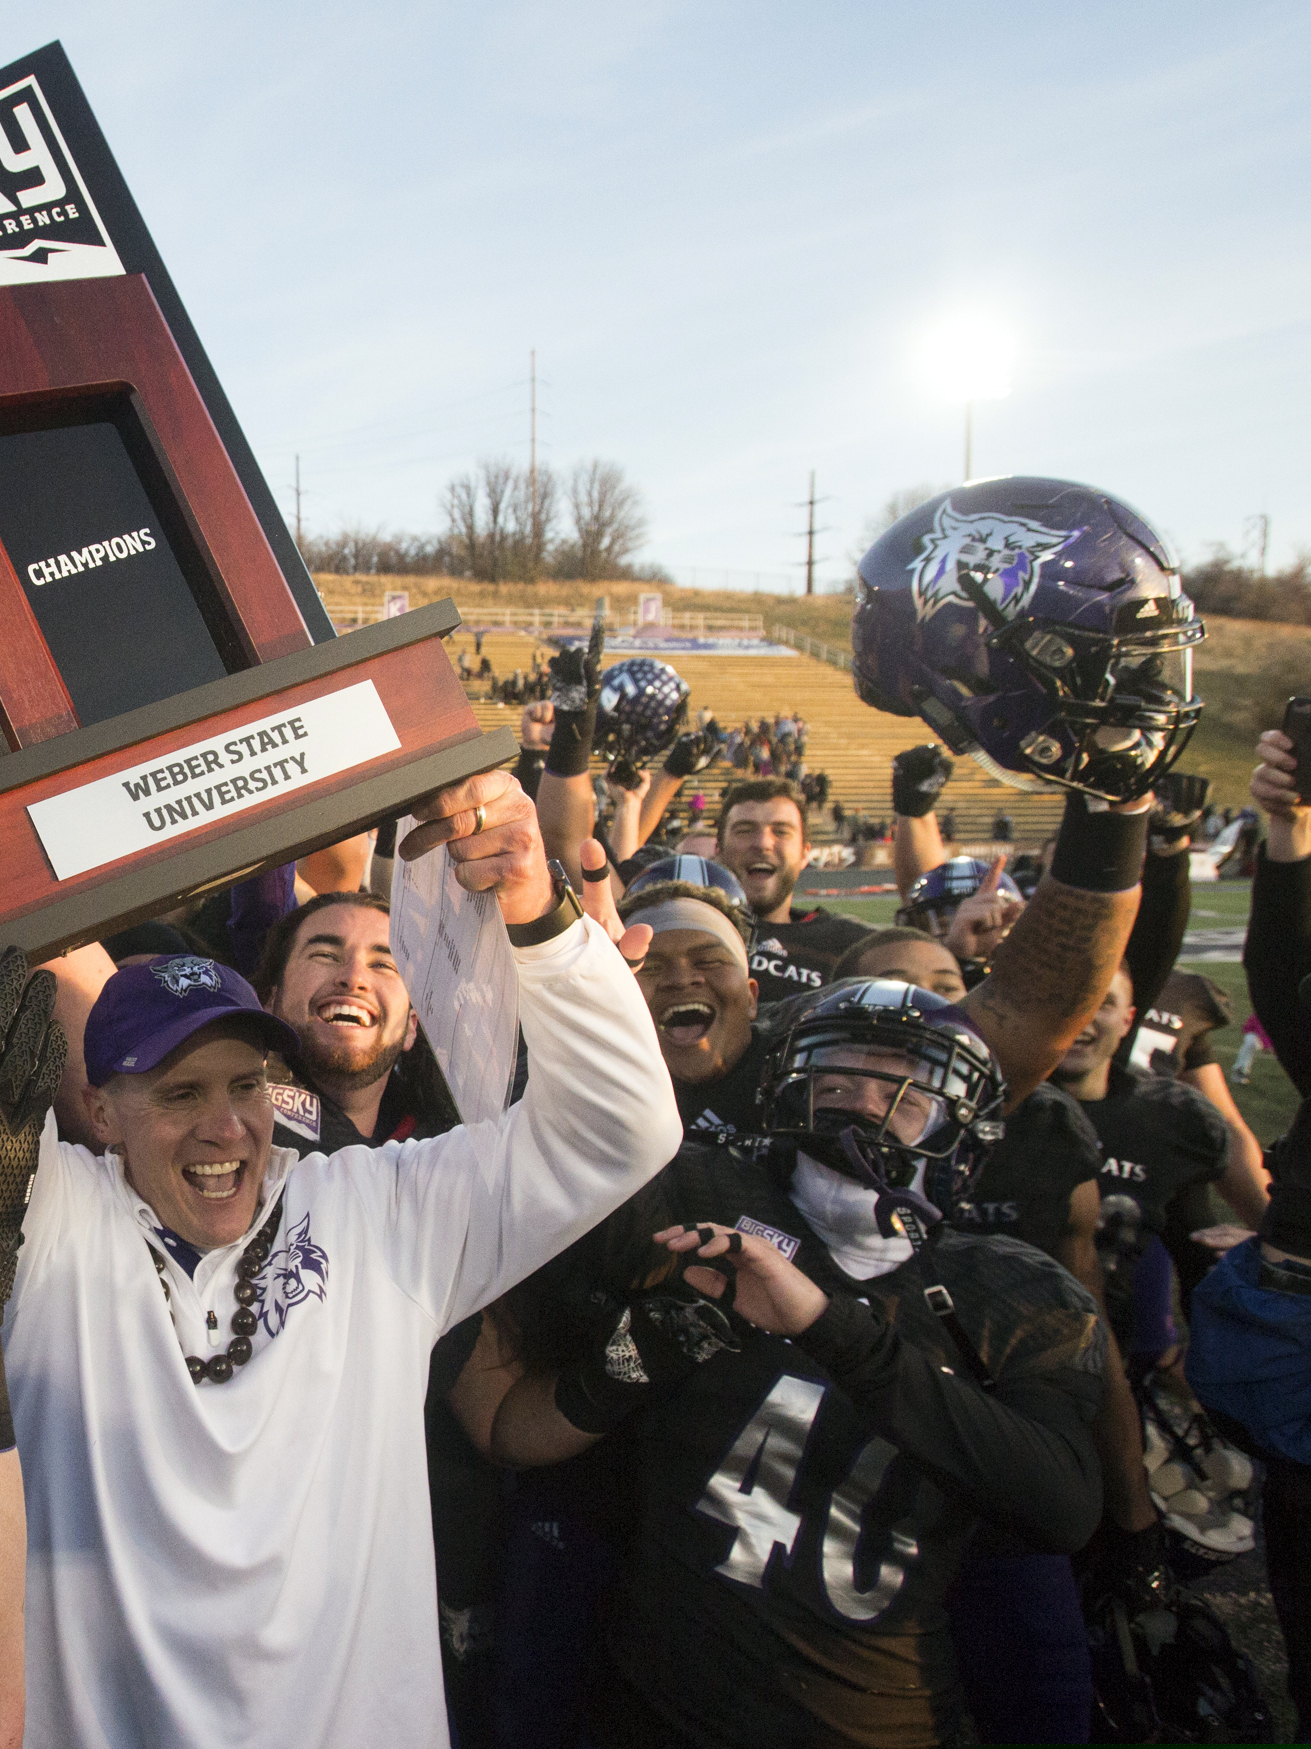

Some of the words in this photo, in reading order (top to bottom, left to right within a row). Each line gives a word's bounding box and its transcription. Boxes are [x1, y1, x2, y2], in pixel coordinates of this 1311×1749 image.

[27, 527, 156, 586] CHAMPIONS
[121, 749, 225, 802] WEBER
[224, 716, 309, 765] STATE
[142, 751, 309, 832] UNIVERSITY
[751, 954, 822, 988] DCATS
[1144, 1008, 1184, 1030] ATS
[1101, 1157, 1147, 1182] ATS
